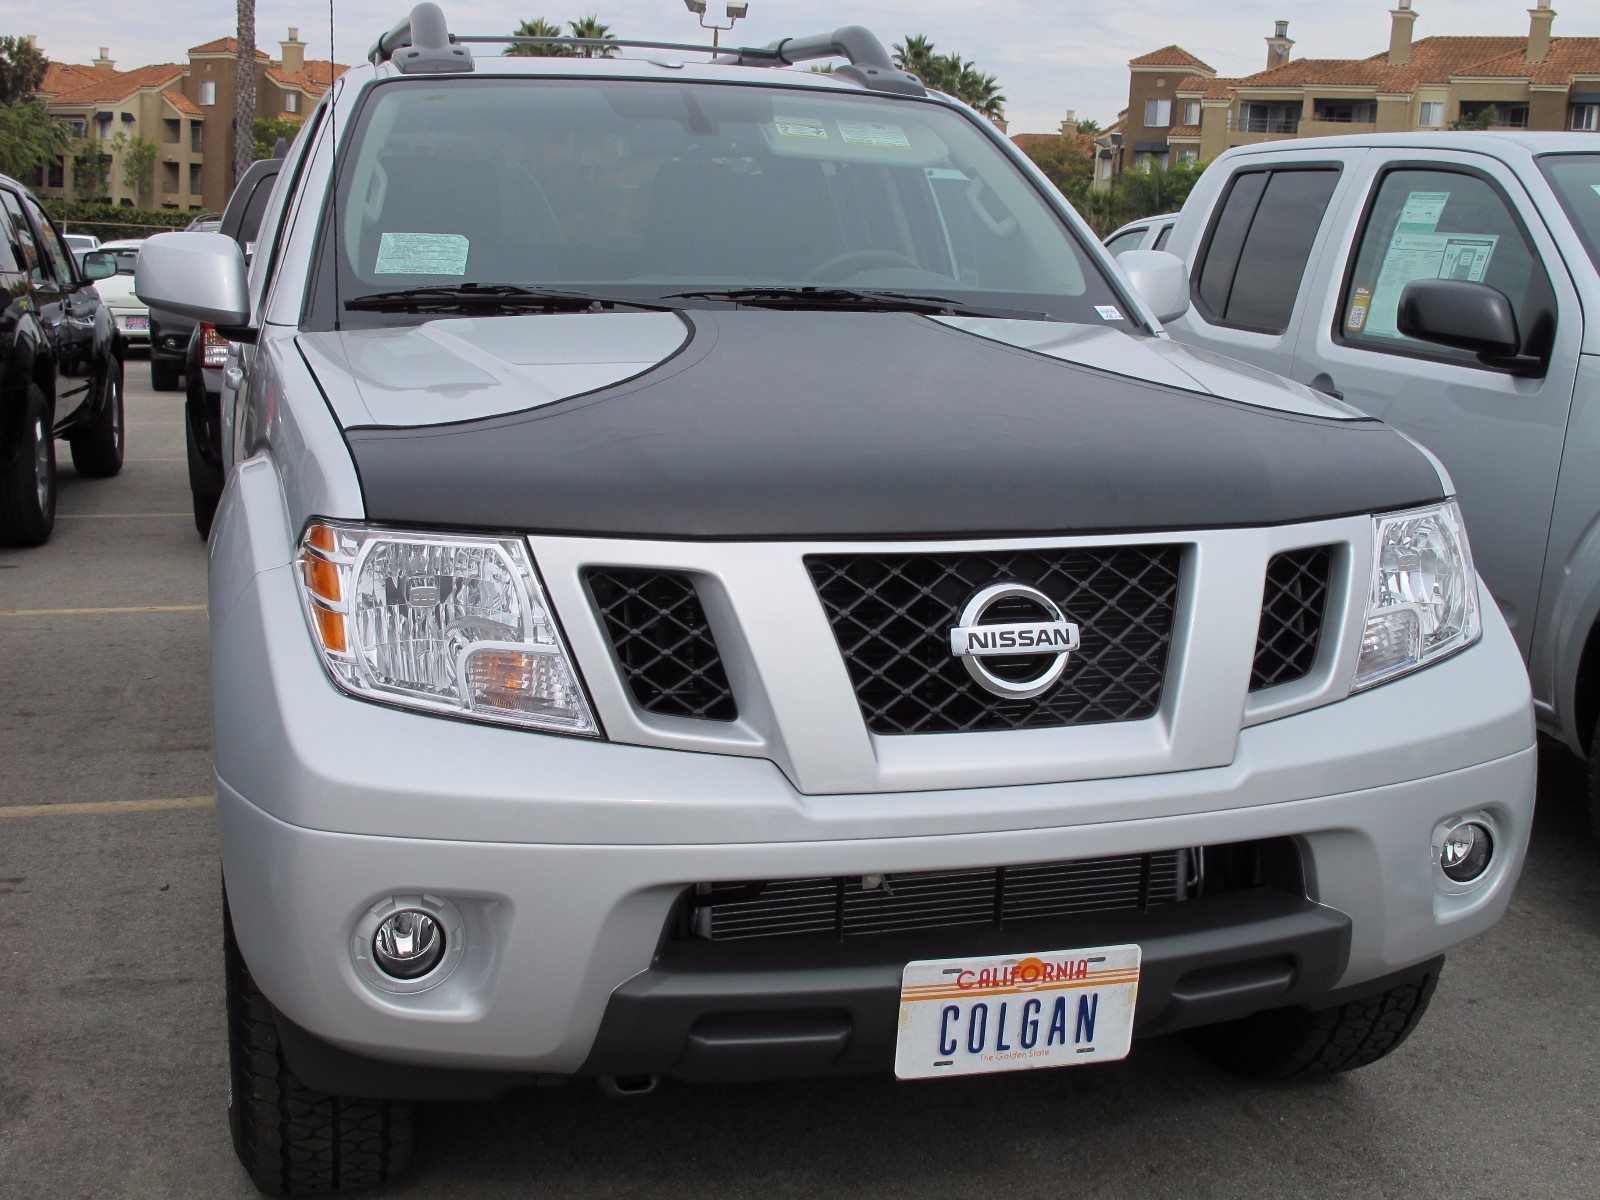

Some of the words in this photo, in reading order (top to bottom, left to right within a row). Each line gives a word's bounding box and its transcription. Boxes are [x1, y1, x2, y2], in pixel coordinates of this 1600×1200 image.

[967, 628, 1071, 650] NISSAN
[956, 959, 1088, 990] CALIFORNIA
[939, 992, 1099, 1056] COLGAN
[980, 1053, 994, 1061] The
[996, 1051, 1027, 1061] Golden
[1029, 1049, 1050, 1058] State
